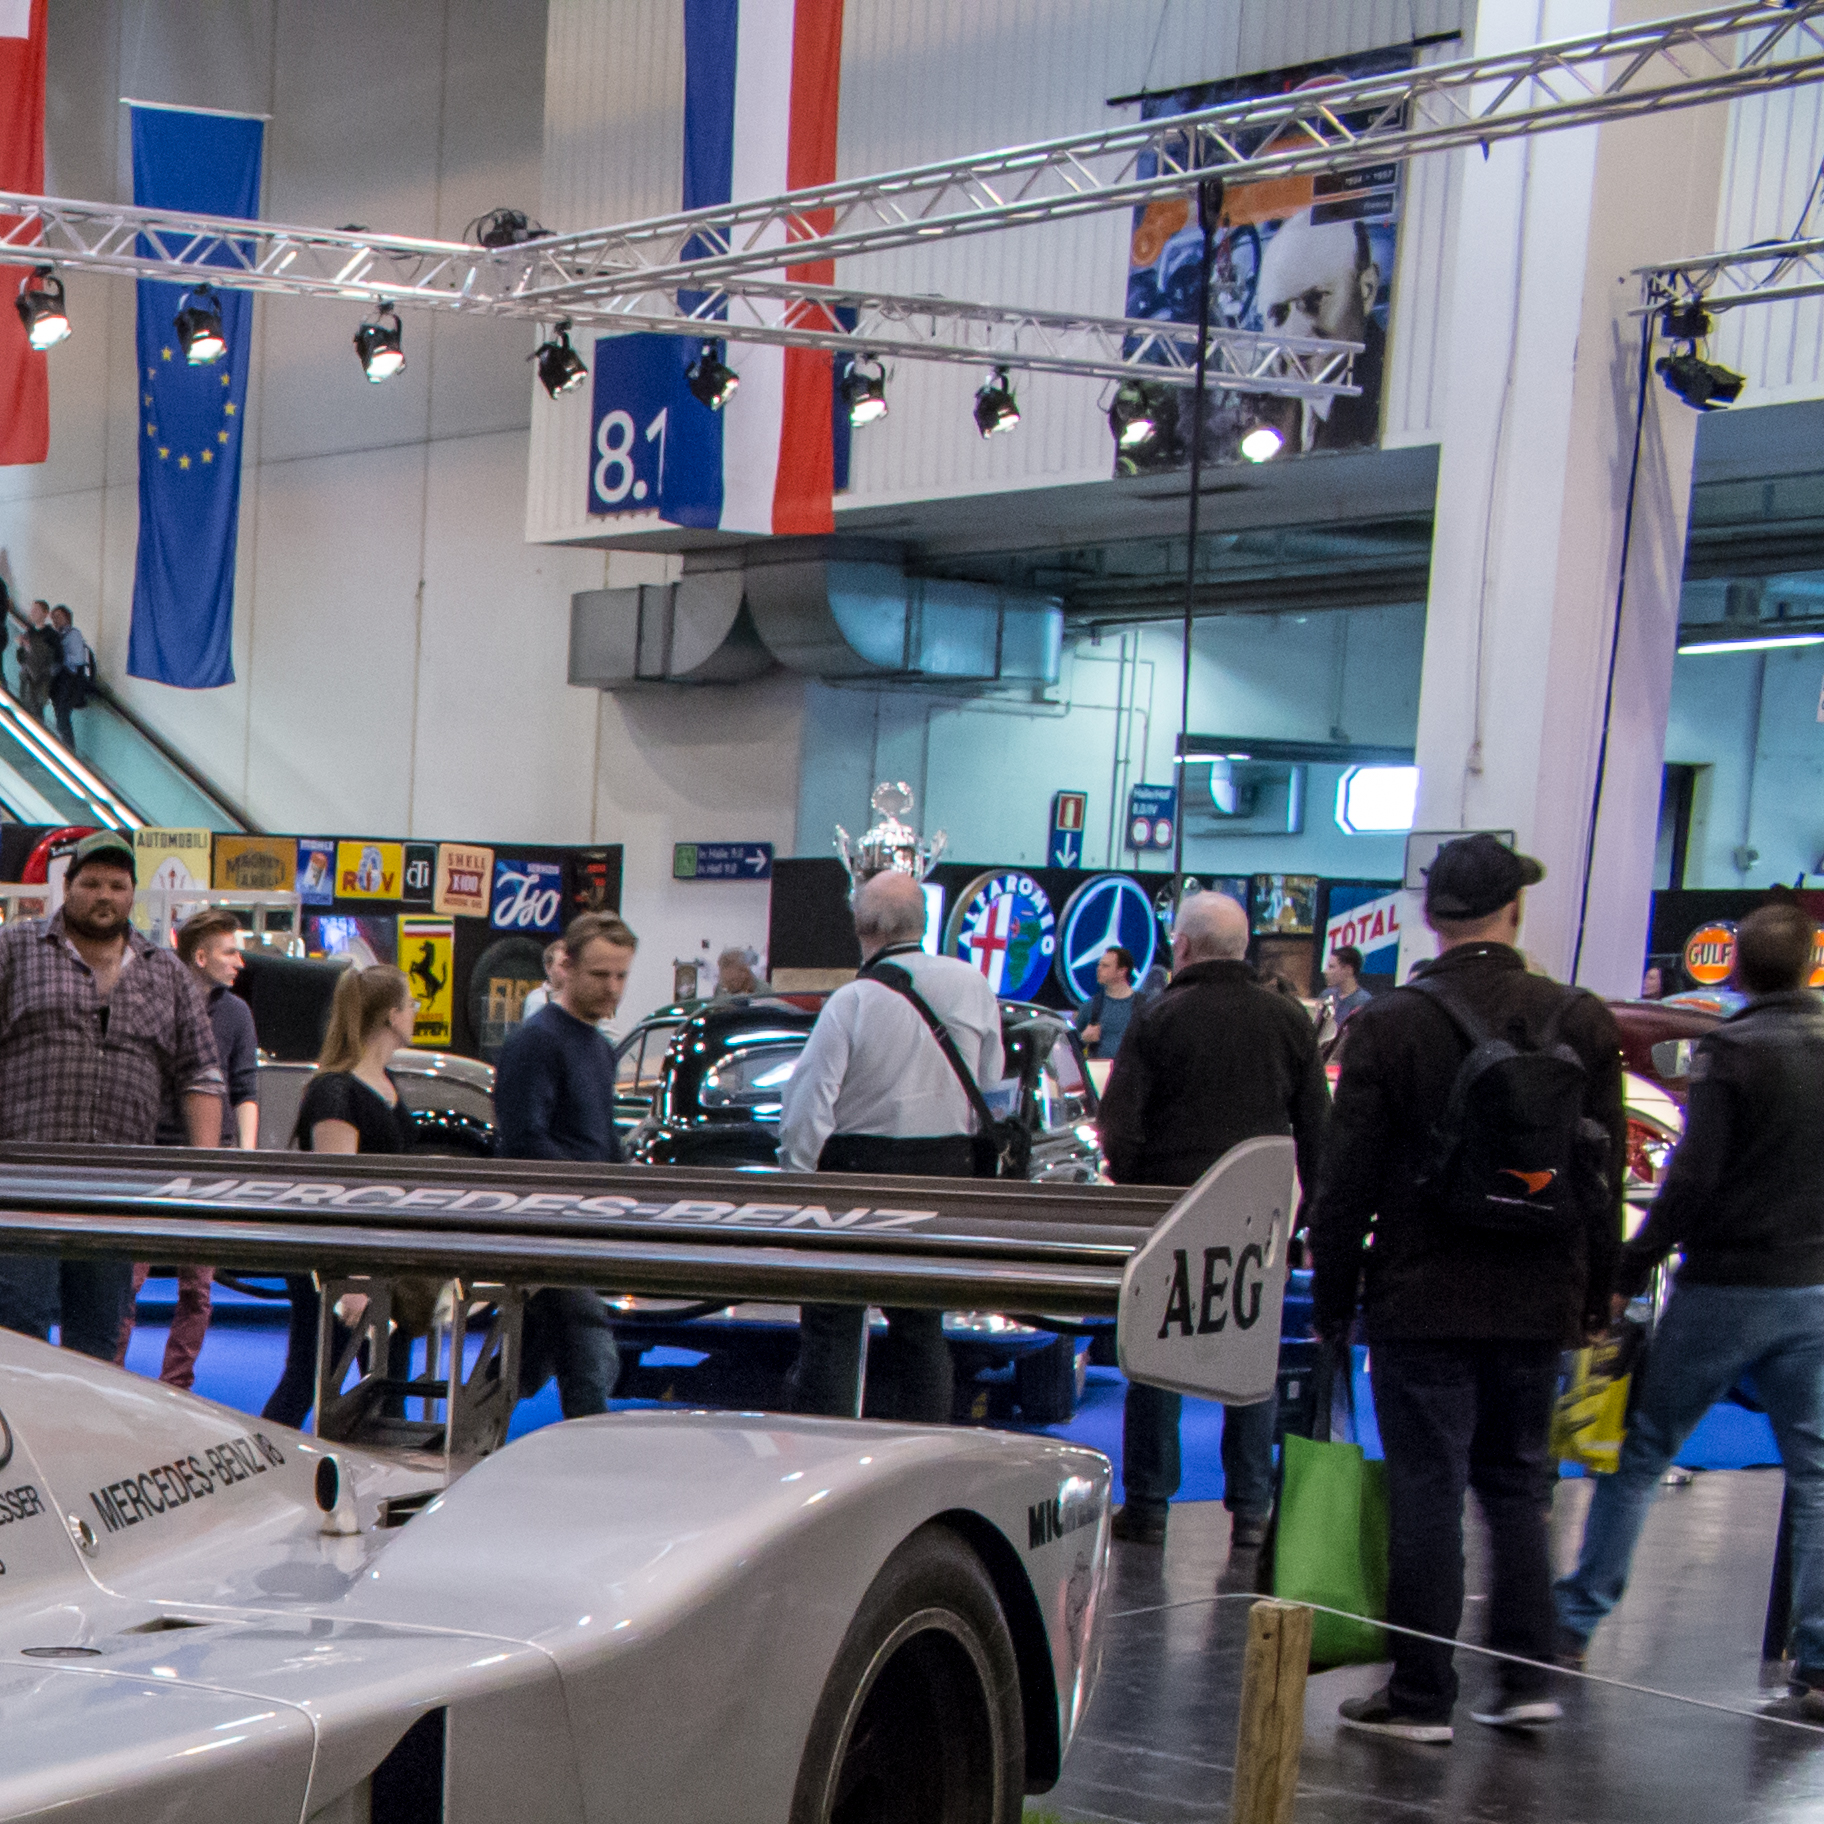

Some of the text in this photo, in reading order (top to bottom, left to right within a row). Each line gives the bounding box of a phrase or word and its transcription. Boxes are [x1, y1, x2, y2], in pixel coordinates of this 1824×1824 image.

[594, 407, 668, 503] 8.1
[136, 831, 209, 848] AUTOMOBILI
[448, 852, 486, 870] SHELL
[1328, 904, 1401, 950] TOTAL
[1689, 942, 1734, 965] GULF
[153, 1176, 940, 1234] MERCEDES-BENZ
[1157, 1242, 1266, 1342] AEG
[88, 1436, 268, 1534] MERCEDES-BENZ
